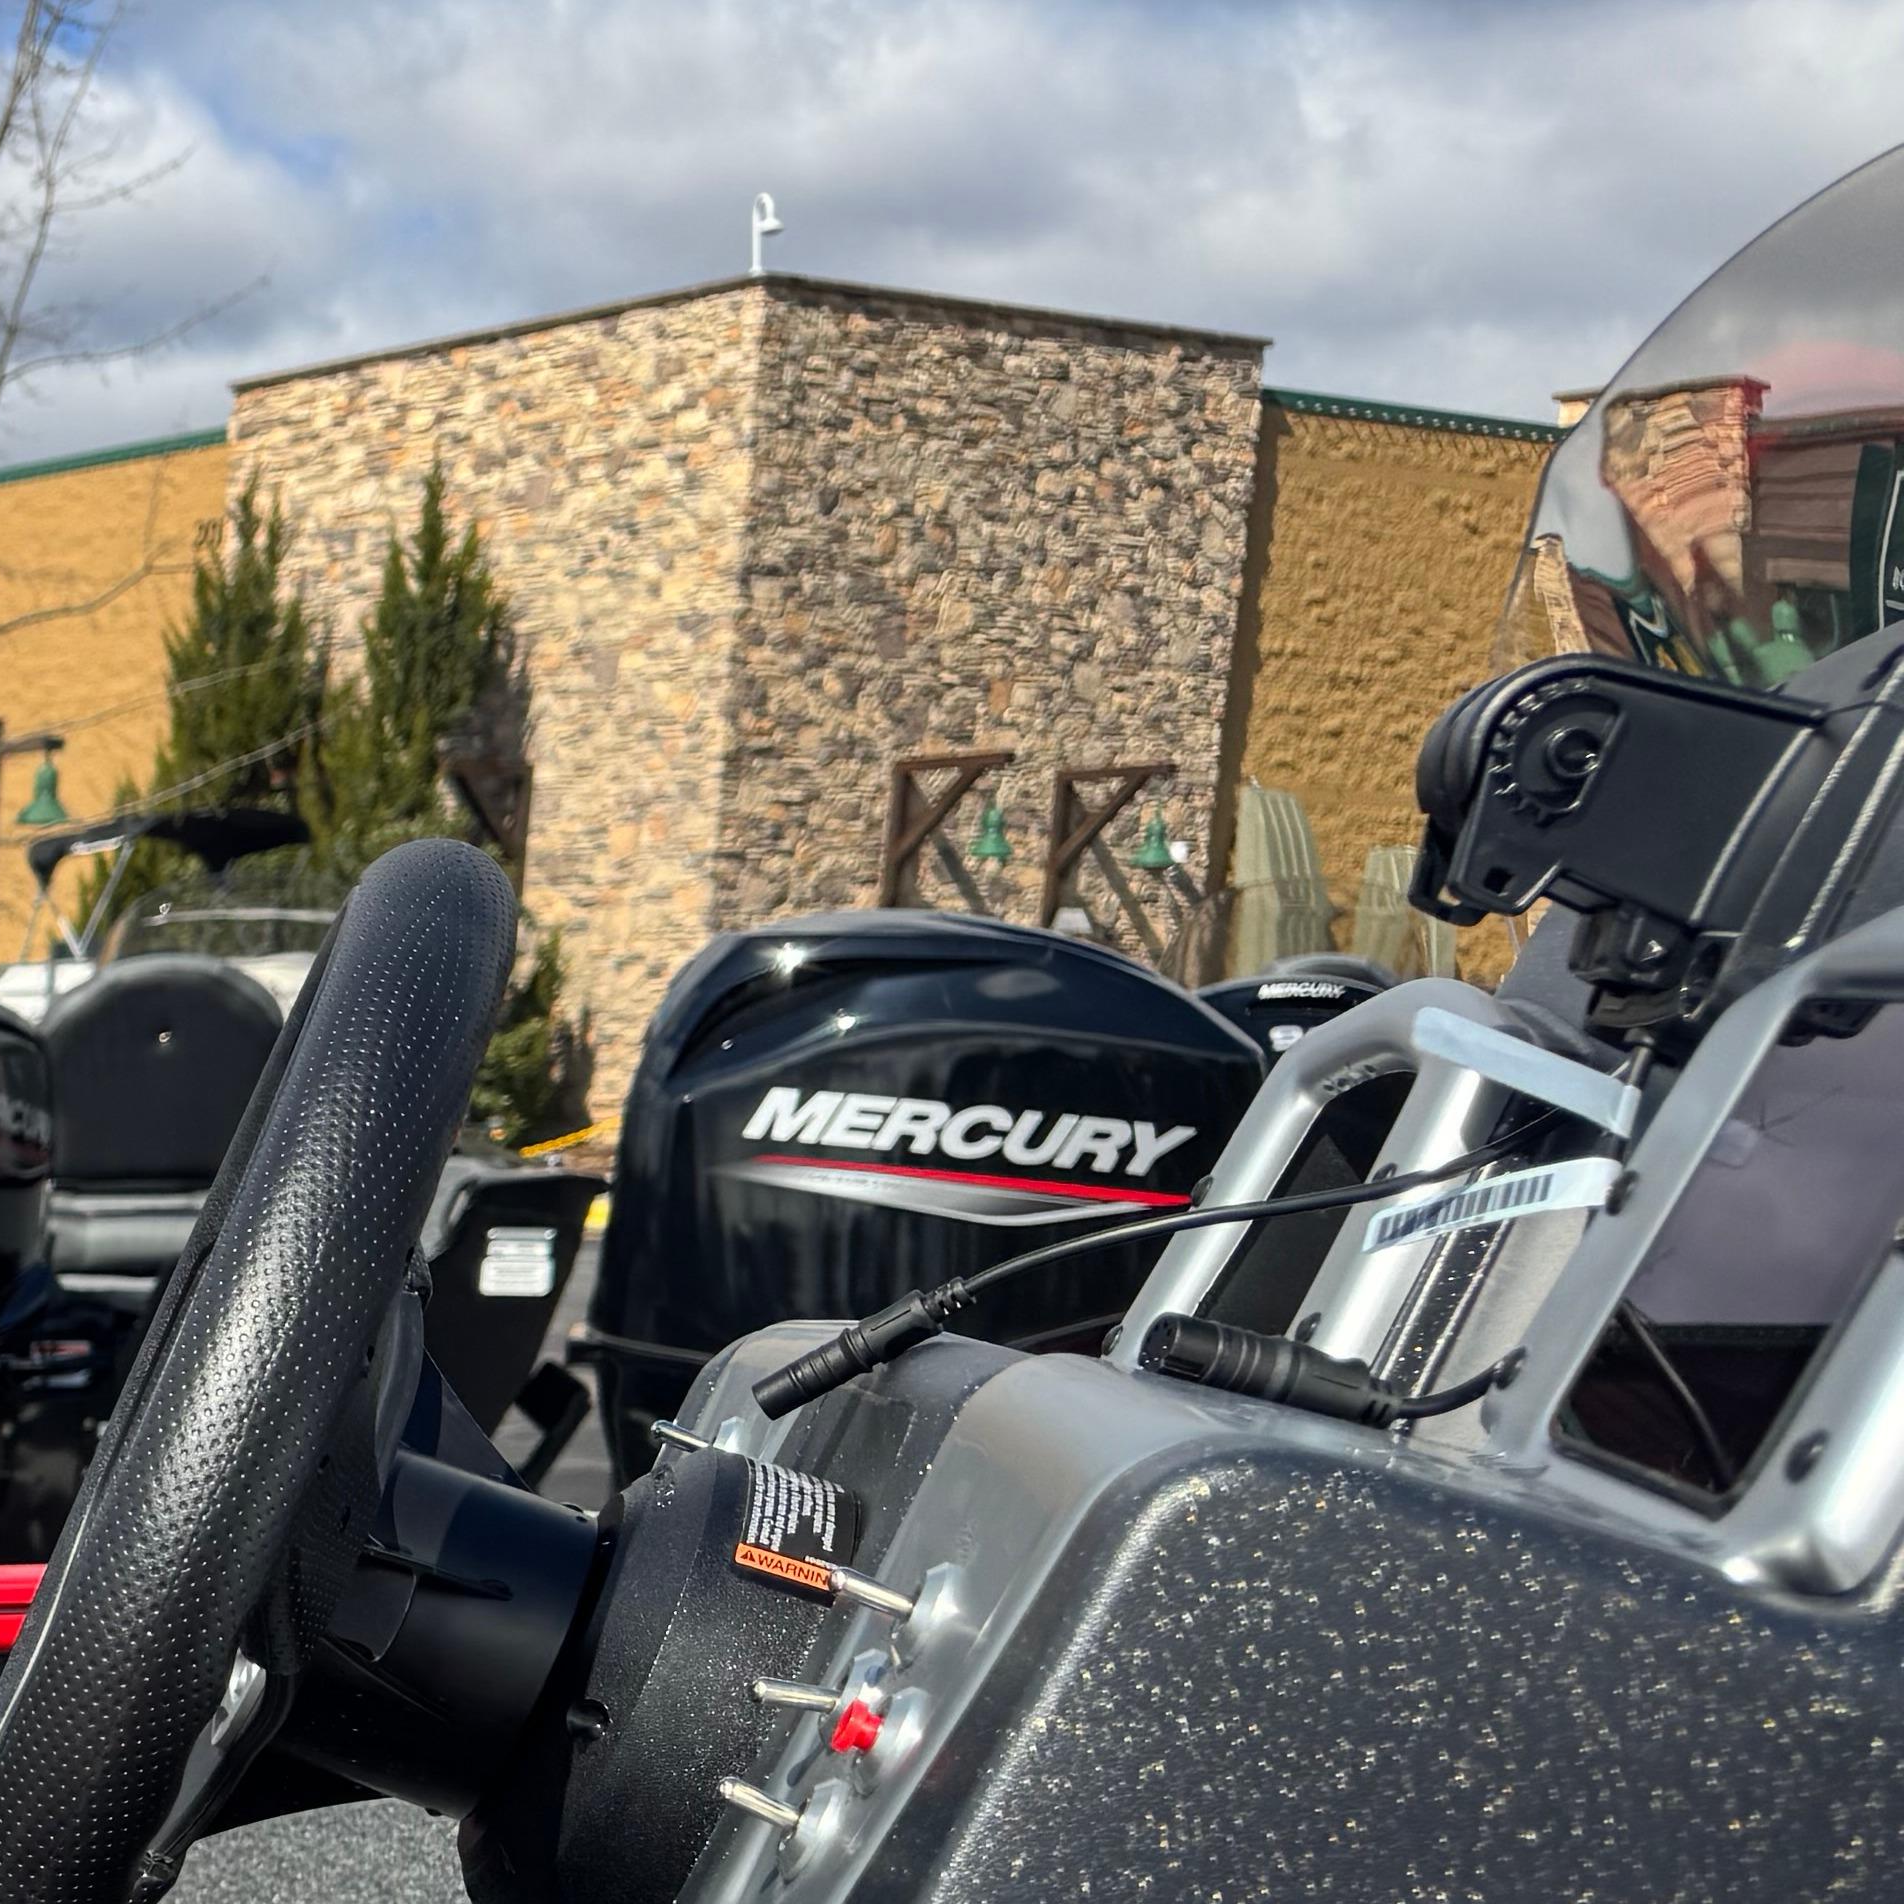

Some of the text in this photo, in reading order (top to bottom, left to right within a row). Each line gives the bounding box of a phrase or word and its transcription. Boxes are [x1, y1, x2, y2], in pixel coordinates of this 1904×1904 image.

[1257, 983, 1347, 1000] MERCURY
[743, 1087, 1197, 1178] MERCURY
[757, 1553, 830, 1587] WARNIN
